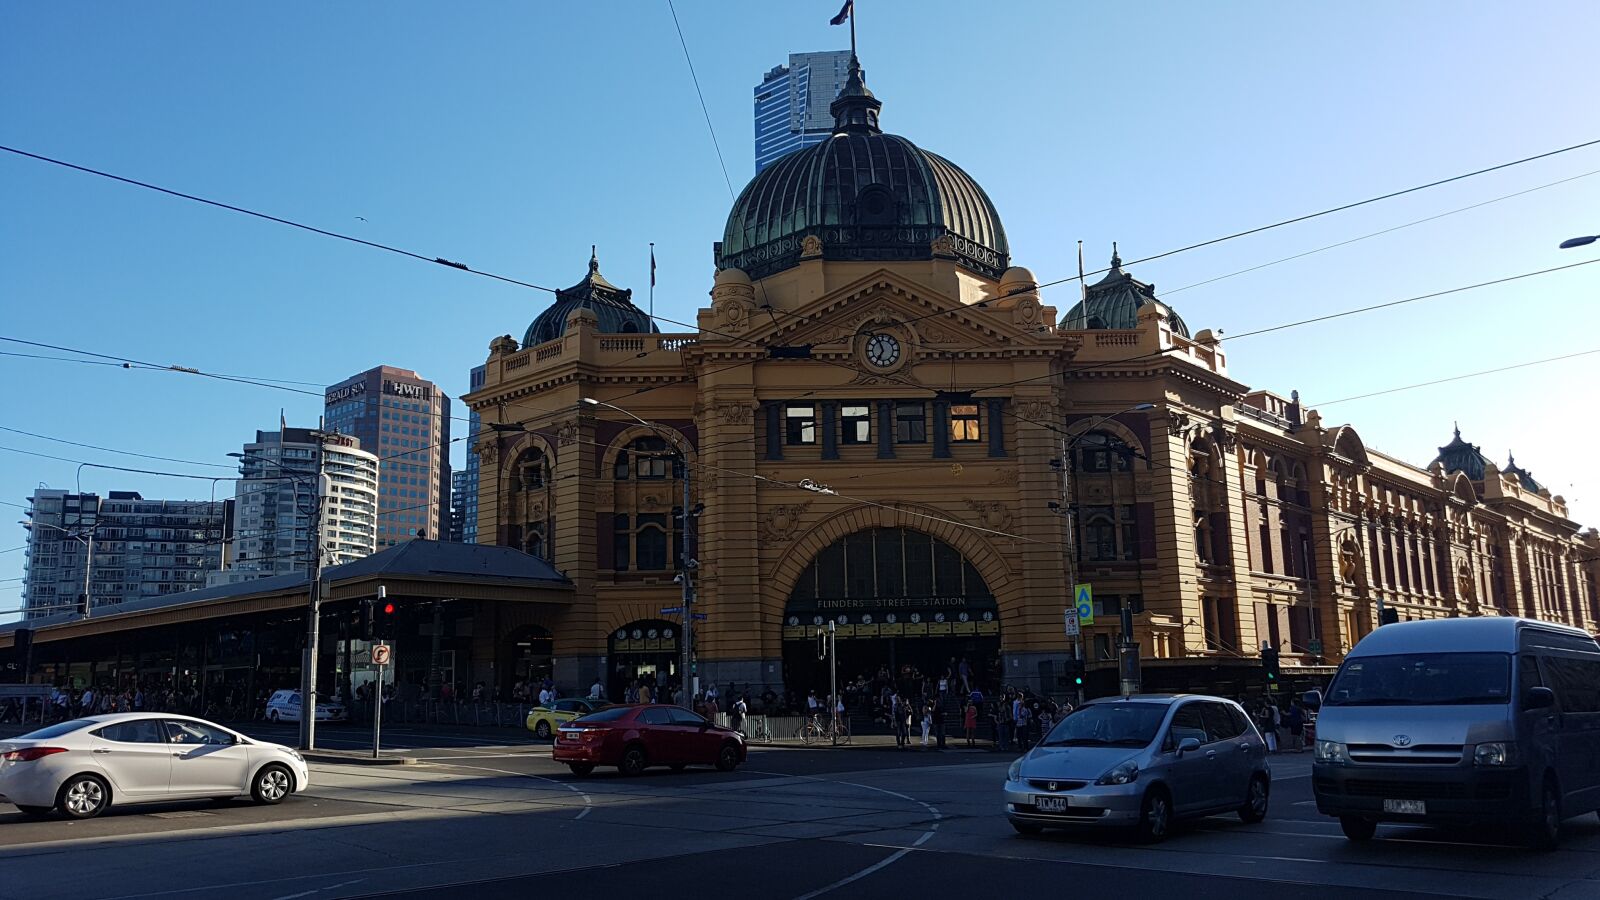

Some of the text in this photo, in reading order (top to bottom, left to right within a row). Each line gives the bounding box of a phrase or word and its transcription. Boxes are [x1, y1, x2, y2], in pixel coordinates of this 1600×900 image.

[352, 382, 365, 393] SUN
[394, 382, 421, 395] HWT
[817, 597, 966, 609] FLINDERS STREET STATION
